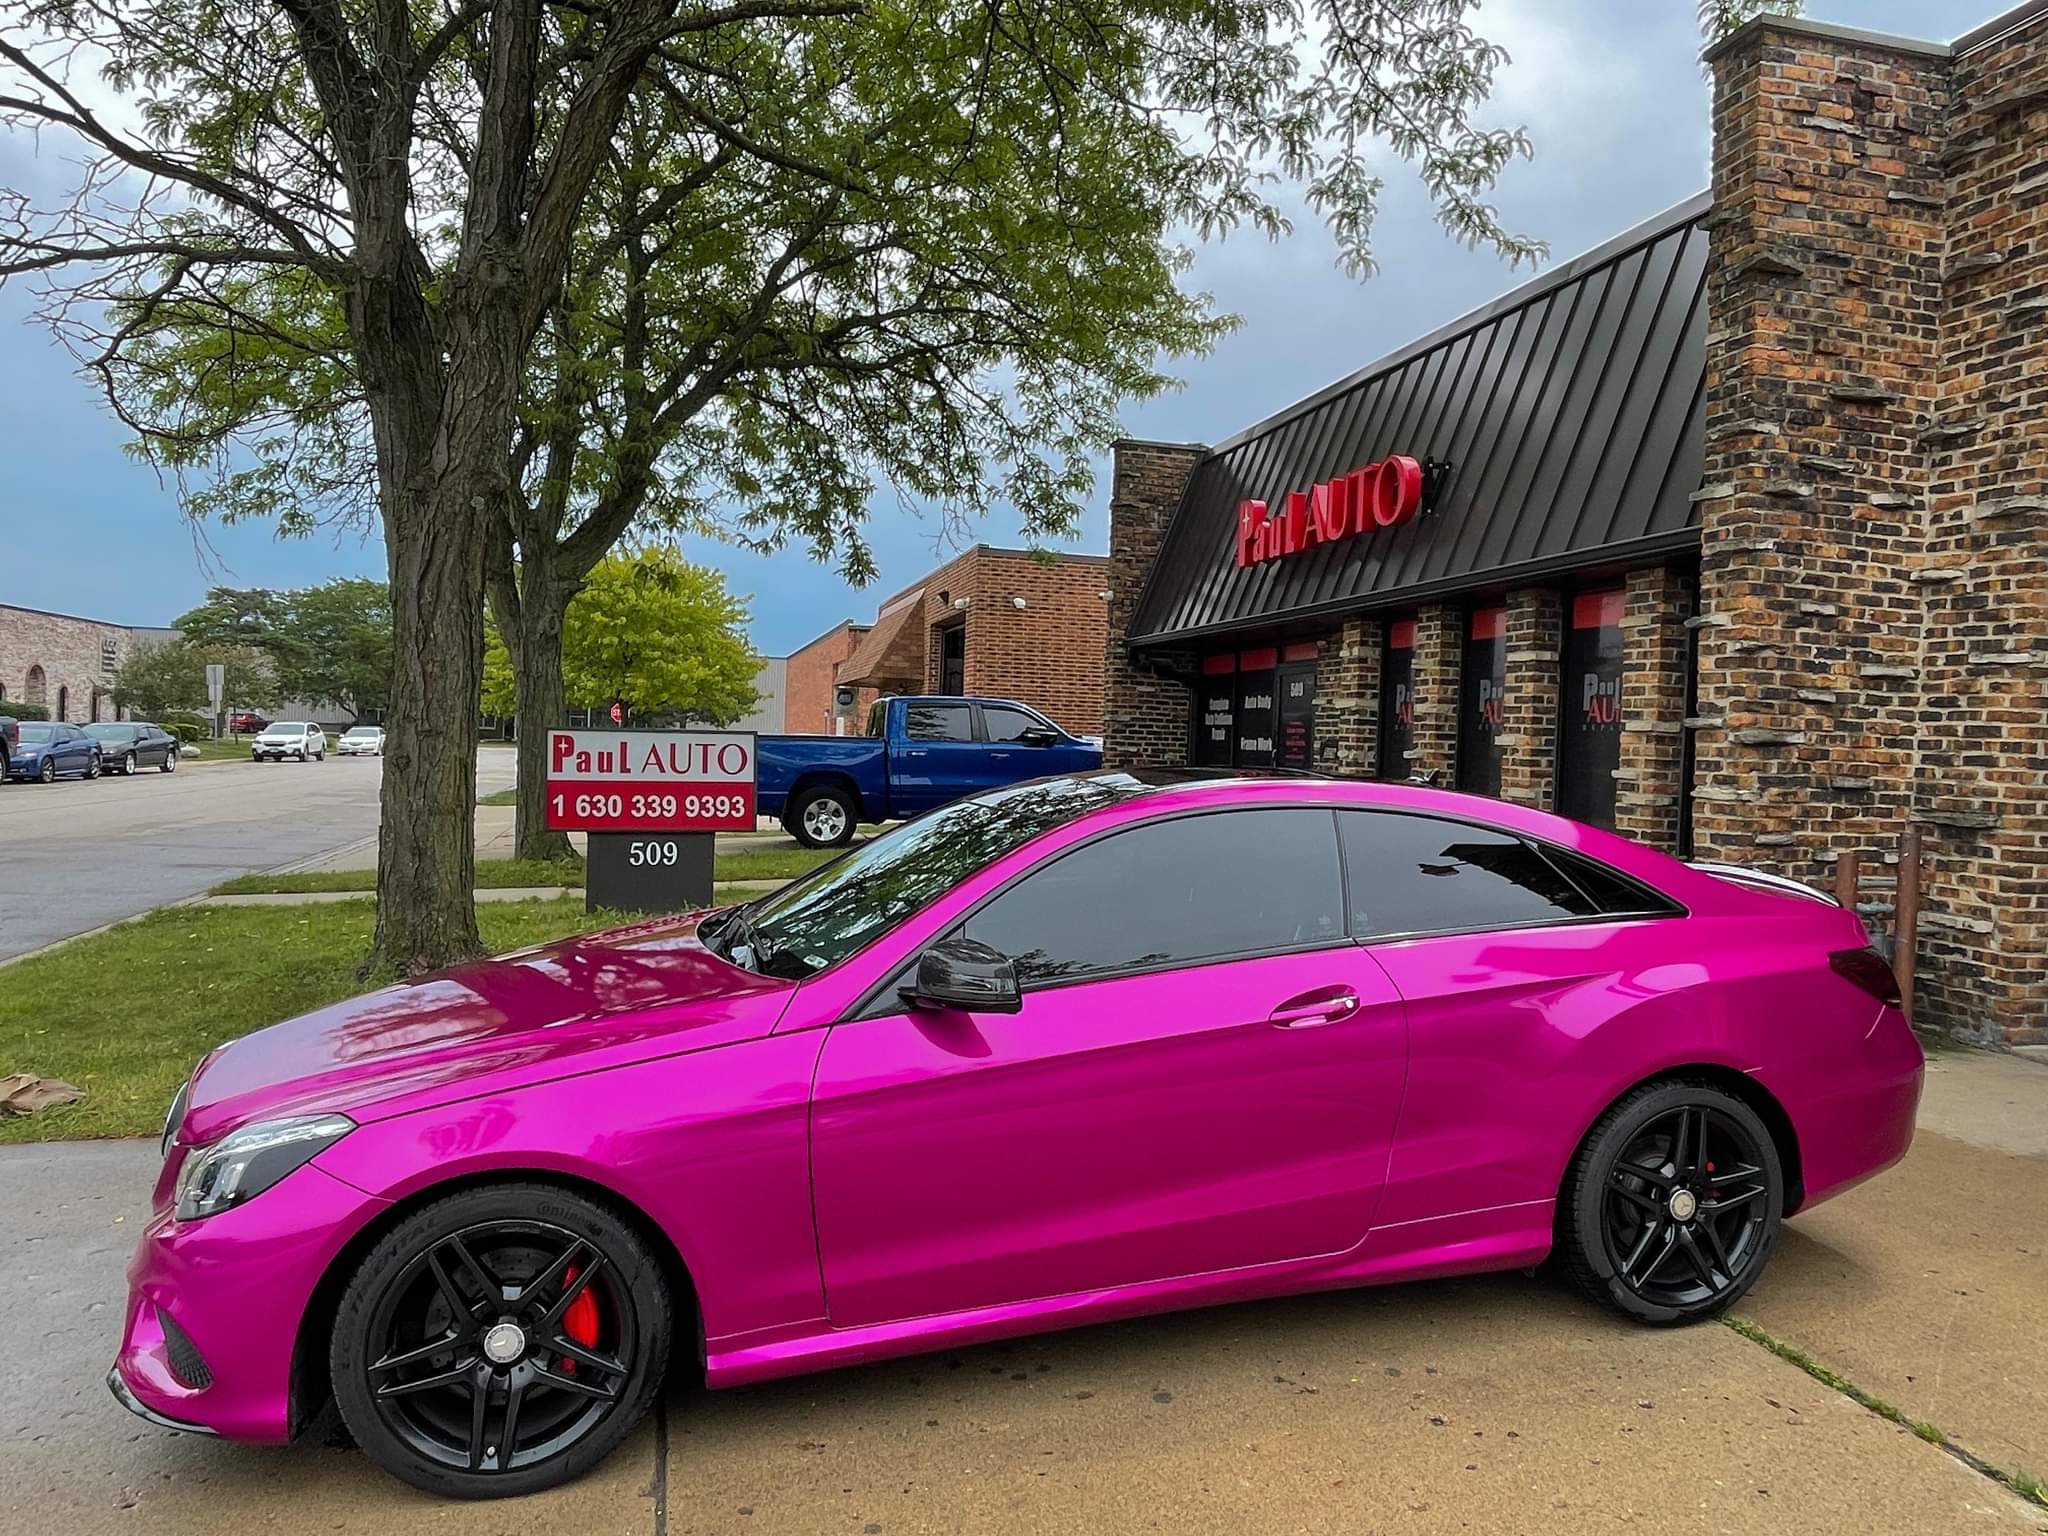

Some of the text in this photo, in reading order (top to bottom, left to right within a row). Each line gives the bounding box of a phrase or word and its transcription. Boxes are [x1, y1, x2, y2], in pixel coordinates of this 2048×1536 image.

[1237, 454, 1422, 567] Paul AUTO
[552, 734, 748, 775] Paul AUTO
[552, 794, 745, 818] 1 630 339 9393
[629, 841, 678, 866] 509
